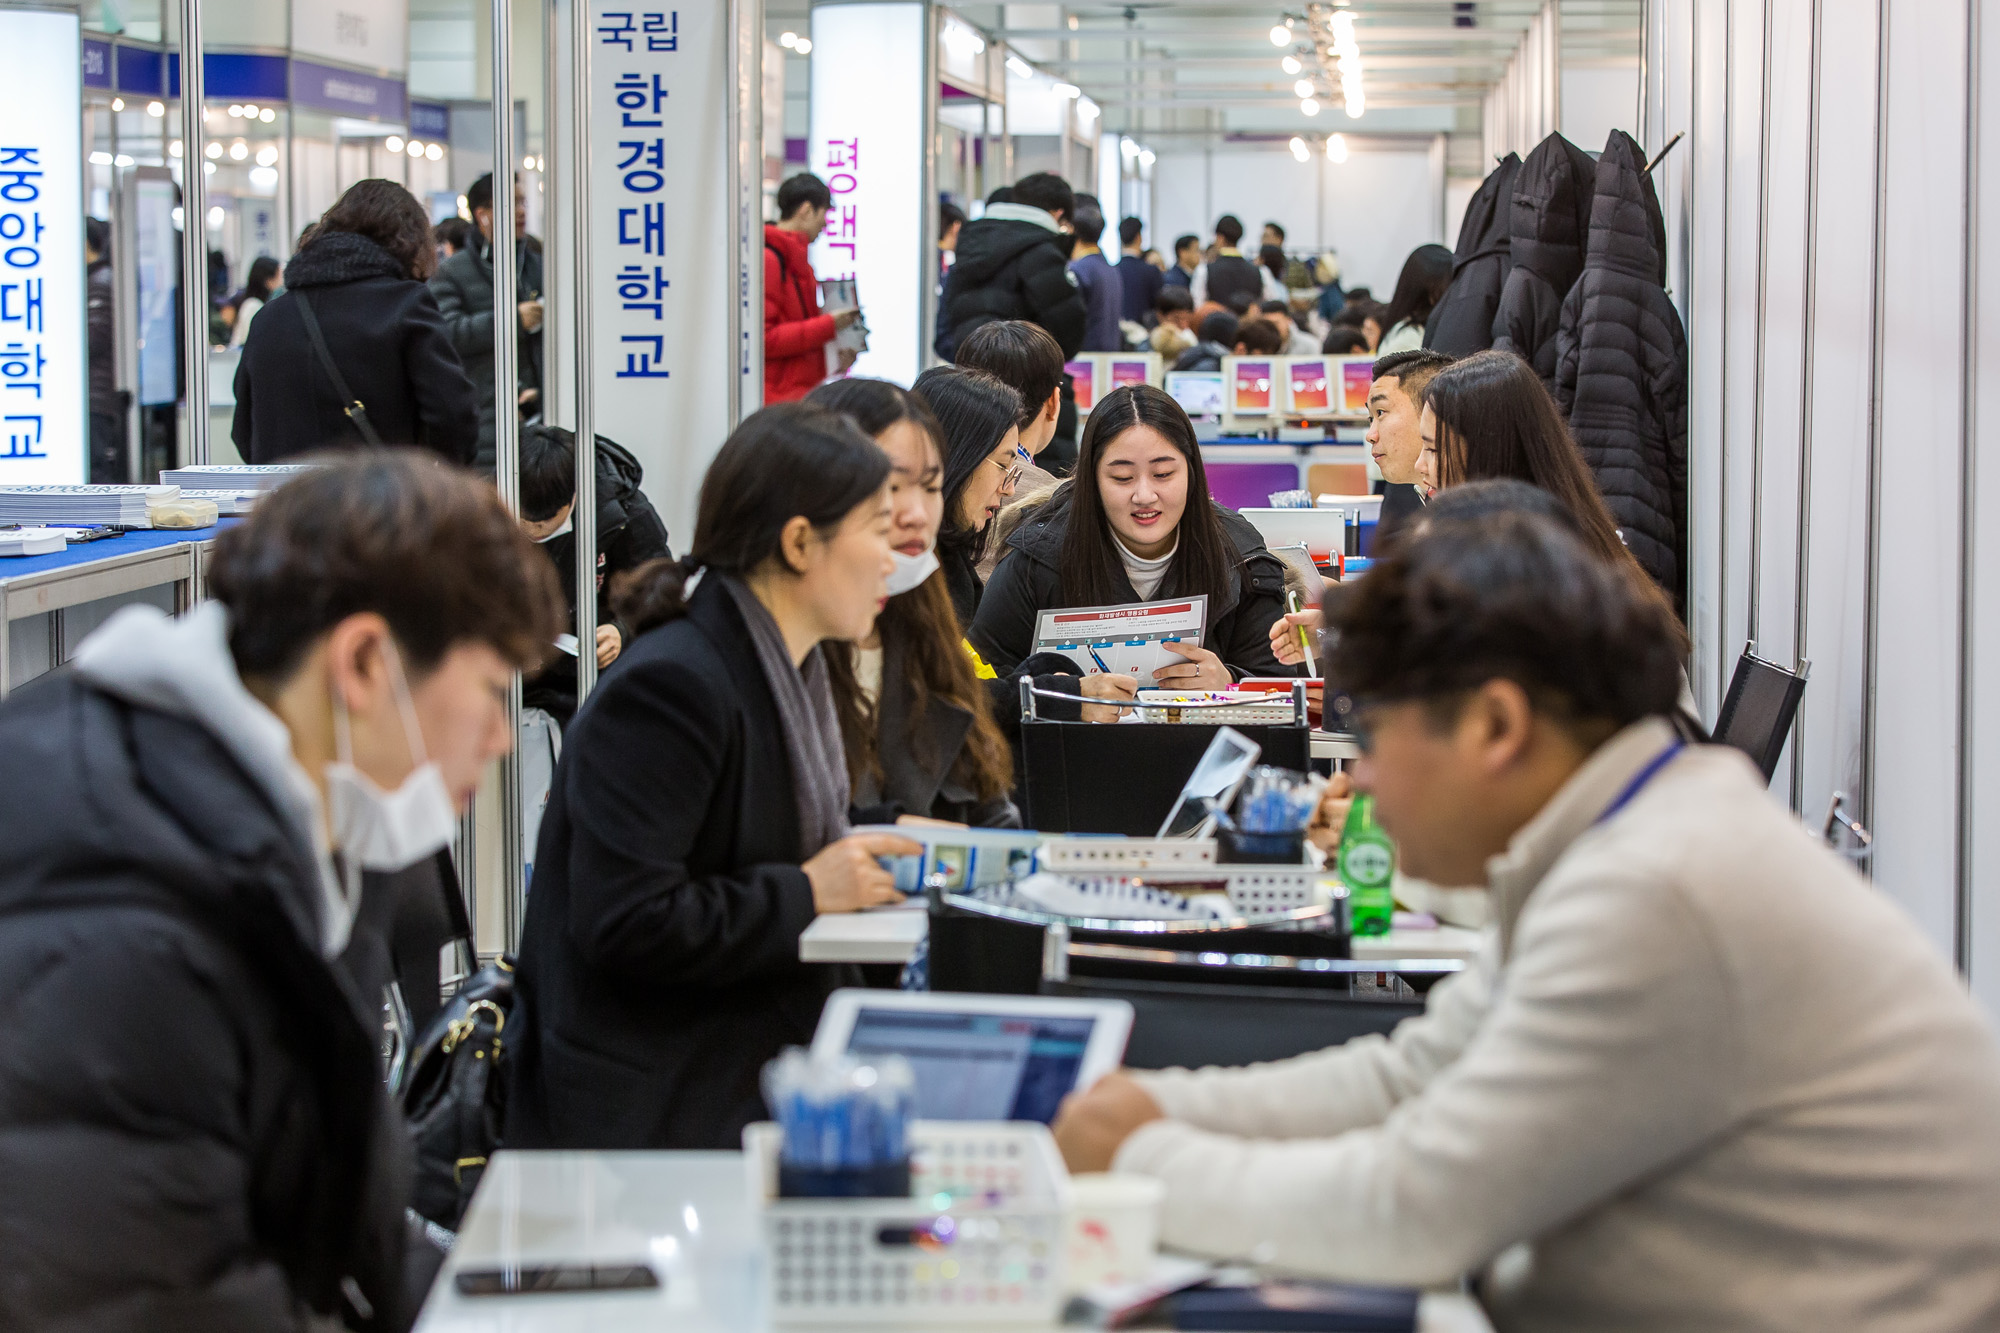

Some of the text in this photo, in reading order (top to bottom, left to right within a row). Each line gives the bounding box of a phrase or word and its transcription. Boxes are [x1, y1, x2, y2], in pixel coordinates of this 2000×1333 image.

[598, 11, 678, 52] 국립
[0, 146, 48, 459] 중앙대학교
[614, 73, 670, 378] 한경대학교
[825, 138, 858, 281] 평택
